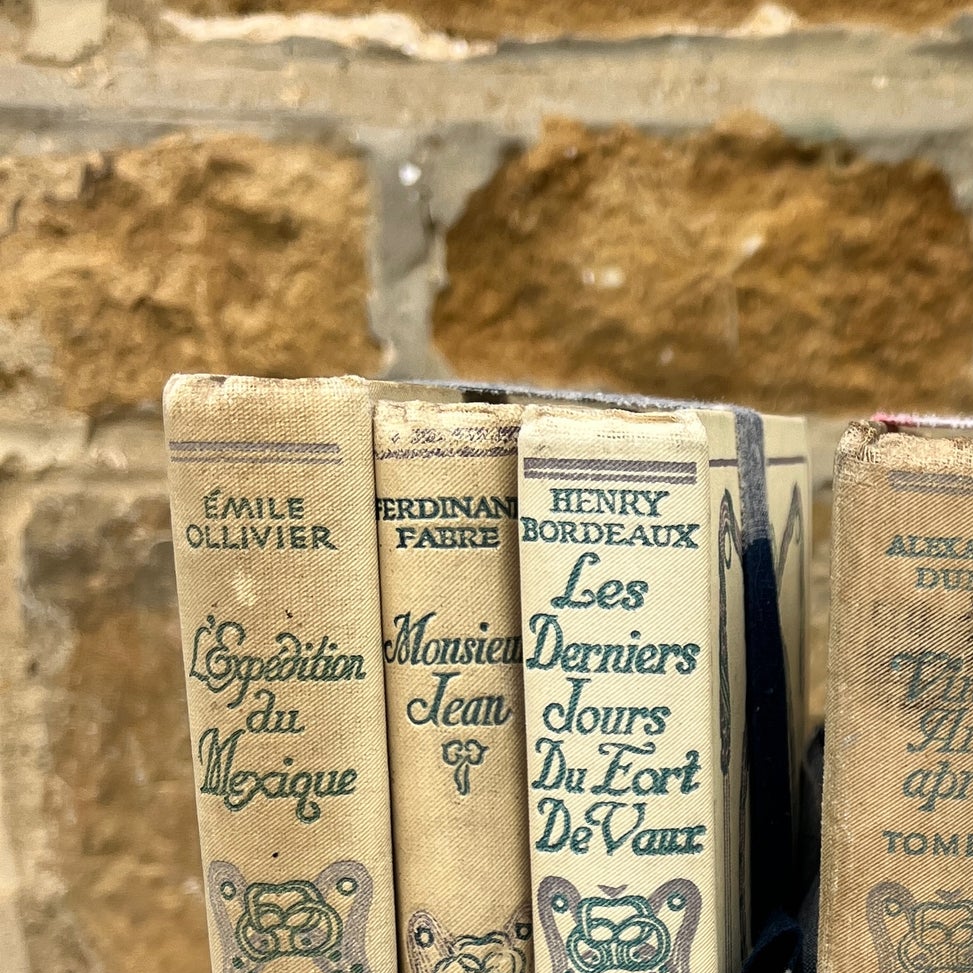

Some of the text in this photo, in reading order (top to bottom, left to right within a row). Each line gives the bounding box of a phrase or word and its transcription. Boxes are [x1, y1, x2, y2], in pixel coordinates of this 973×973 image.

[203, 489, 305, 519] ÉMILE
[549, 488, 669, 517] HENRY
[185, 525, 338, 550] OLLIVIER
[396, 526, 500, 549] FABRE
[520, 516, 700, 549] BORDEAUX
[551, 552, 649, 612] Les
[384, 611, 523, 666] Monsieu
[526, 613, 701, 675] Derniers
[246, 689, 306, 734] du
[406, 672, 513, 727] Jean
[542, 677, 672, 735] Jours
[198, 728, 358, 824] Mexique
[531, 737, 702, 796] Du Fort
[535, 798, 706, 856] De Vaux
